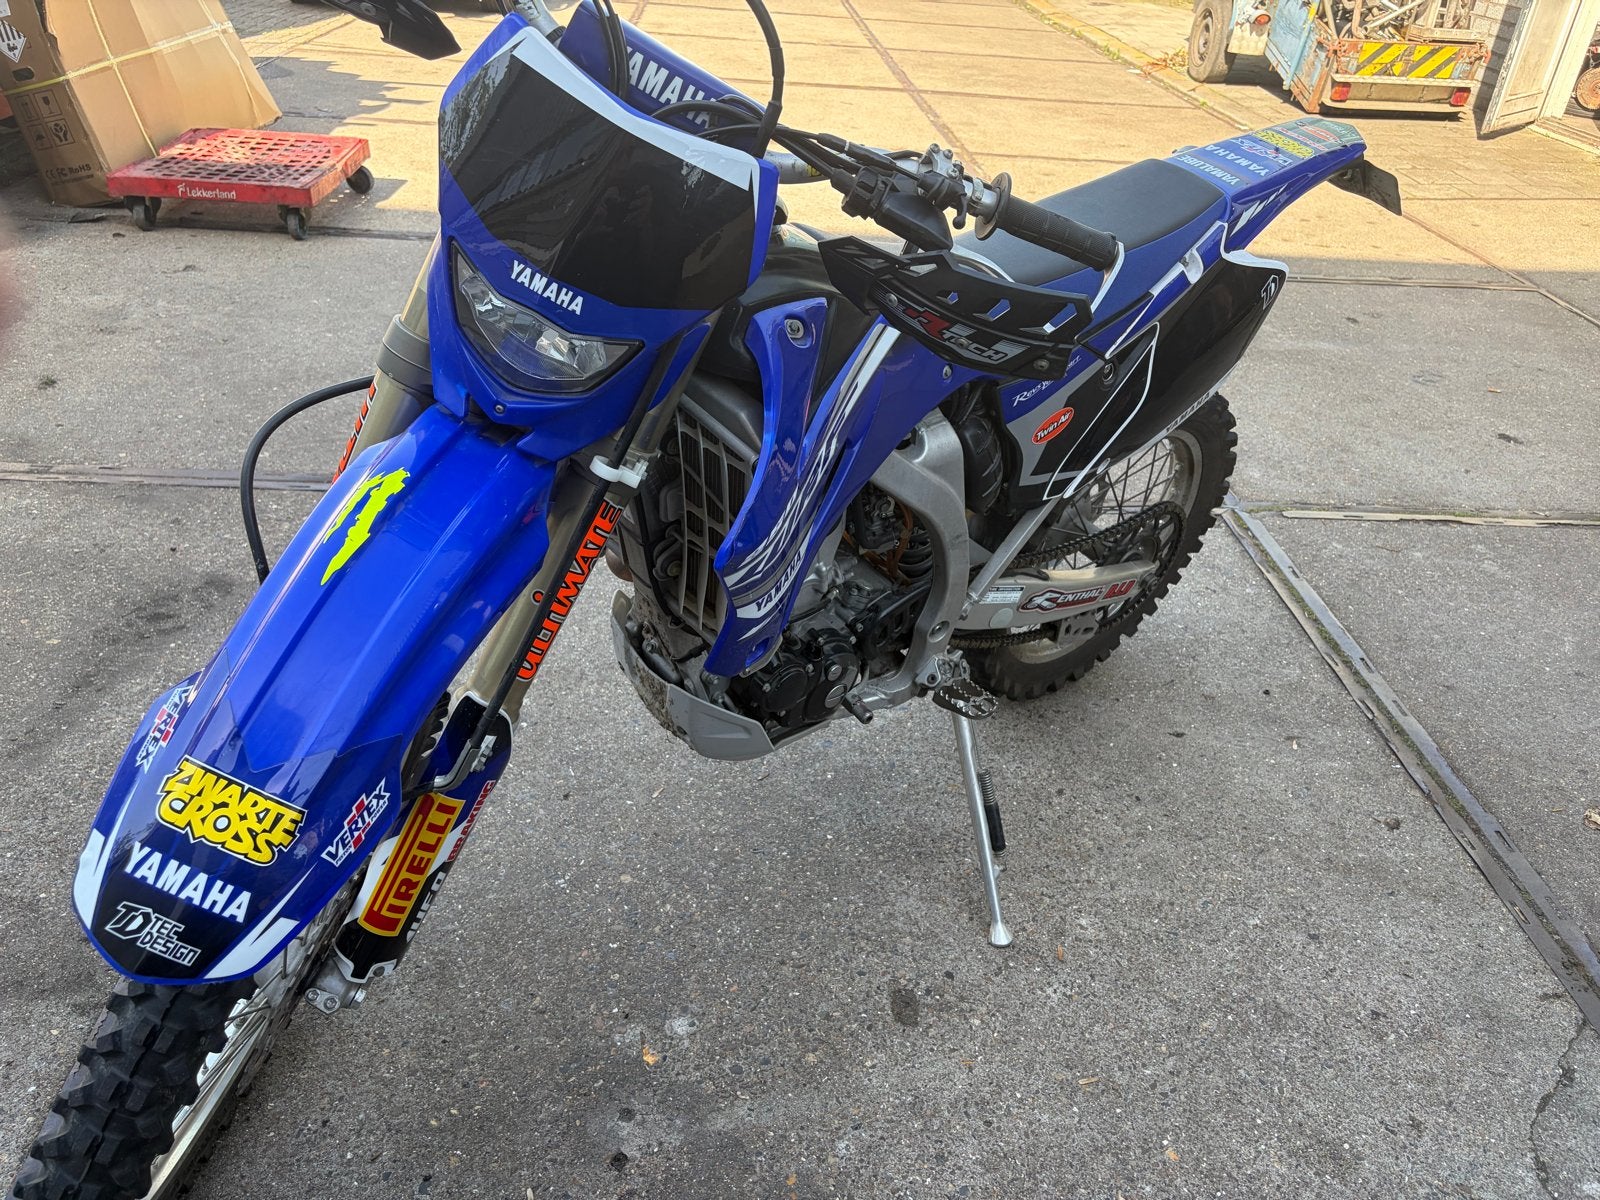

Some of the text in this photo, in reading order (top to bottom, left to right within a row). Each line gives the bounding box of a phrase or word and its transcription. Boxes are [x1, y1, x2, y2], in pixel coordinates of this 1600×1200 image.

[626, 46, 717, 128] AMAHA
[1177, 154, 1241, 186] YAMALUBE
[1205, 144, 1270, 177] YAMAHA
[186, 186, 237, 200] Lekkerland
[510, 259, 584, 316] YAMAHA
[1035, 410, 1073, 441] Twin Air
[755, 550, 802, 612] YAMAHA
[159, 790, 277, 864] CROSS
[163, 759, 303, 848] ZWARTE
[323, 778, 390, 862] VERTEX
[445, 779, 498, 863] BRAKING
[124, 840, 252, 924] YAMAHA
[362, 792, 459, 932] PIRELLI
[136, 928, 202, 967] DESIGN
[149, 913, 185, 941] TEC
